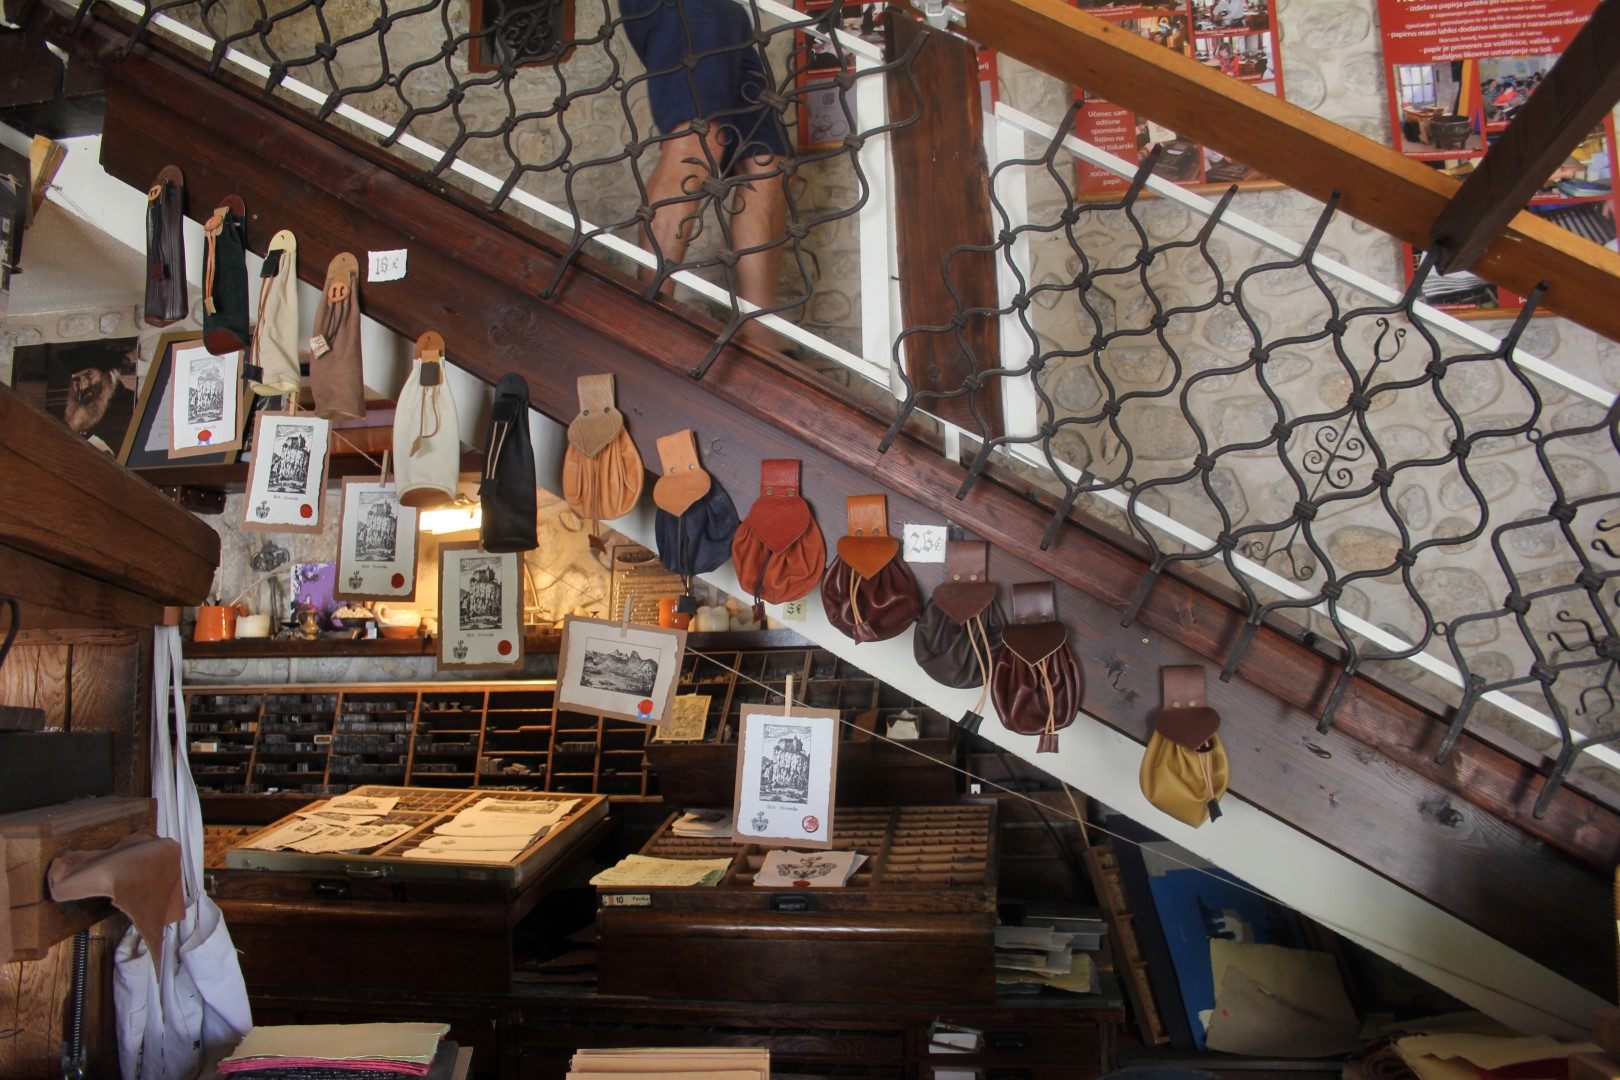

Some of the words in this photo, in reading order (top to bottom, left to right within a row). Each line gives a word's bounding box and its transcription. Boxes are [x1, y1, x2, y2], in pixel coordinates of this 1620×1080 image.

[1489, 22, 1521, 30] okrasimo
[1527, 19, 1562, 27] naravnimi
[1451, 43, 1482, 52] primeren
[1491, 47, 1528, 56] ustvarjanje
[1091, 127, 1127, 135] spominsko
[1107, 142, 1133, 151] tiskarski
